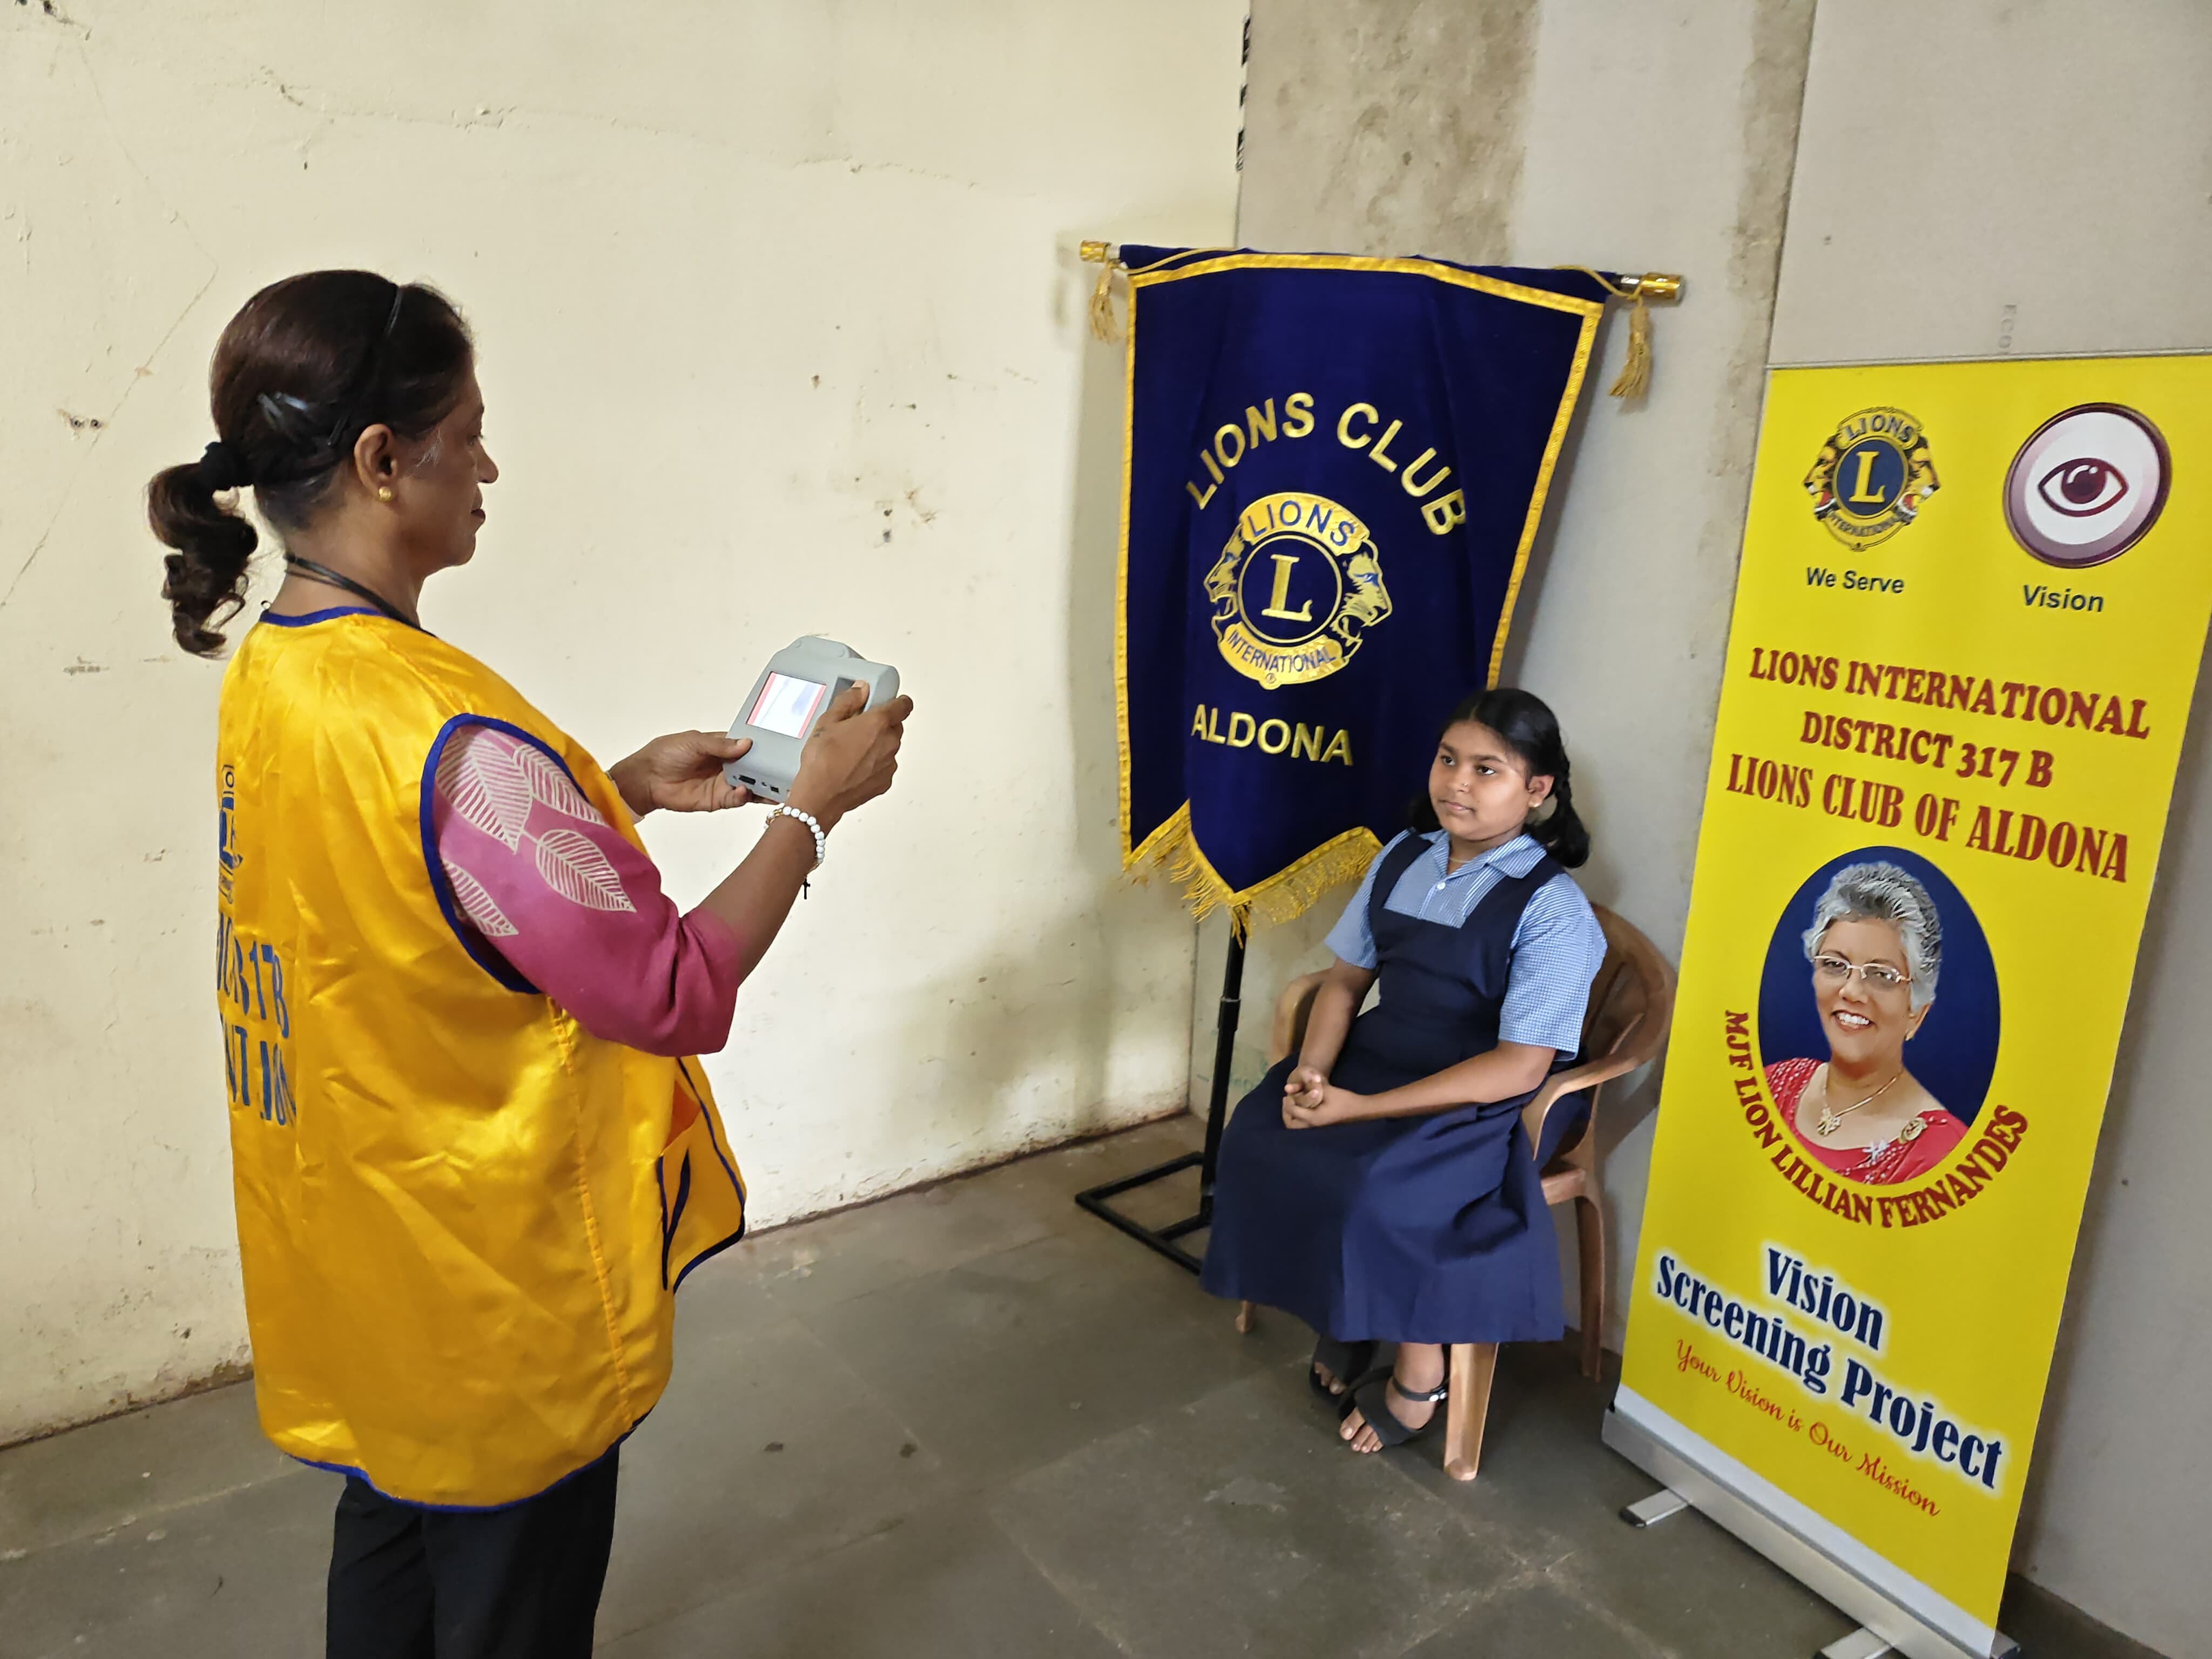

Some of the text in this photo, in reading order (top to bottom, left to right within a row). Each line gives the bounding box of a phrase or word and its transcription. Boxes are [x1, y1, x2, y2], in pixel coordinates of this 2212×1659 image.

[1186, 392, 1466, 535] LIONS CLUB
[1845, 414, 1914, 443] LIONS
[1849, 451, 1885, 503] L
[1247, 503, 1355, 547] LIONS
[1261, 554, 1312, 622] L
[1806, 567, 1905, 594] We Serve
[2022, 584, 2103, 613] Vision
[1227, 629, 1337, 673] INTERNATIONAL
[1749, 647, 2152, 740] LIONS INTERNATIONAL
[1191, 704, 1353, 766] ALDONA
[1800, 711, 2055, 788] DISTRICT 317 B
[1726, 754, 2129, 884] LIONS CLUB OF ALDONA
[1725, 1010, 2028, 1229] MJF LION LILLIAN FERNANDES
[1767, 1247, 1883, 1351] Vision
[1657, 1255, 2003, 1489] Screening Project
[1676, 1338, 1941, 1517] Your Vision is Our Mission
